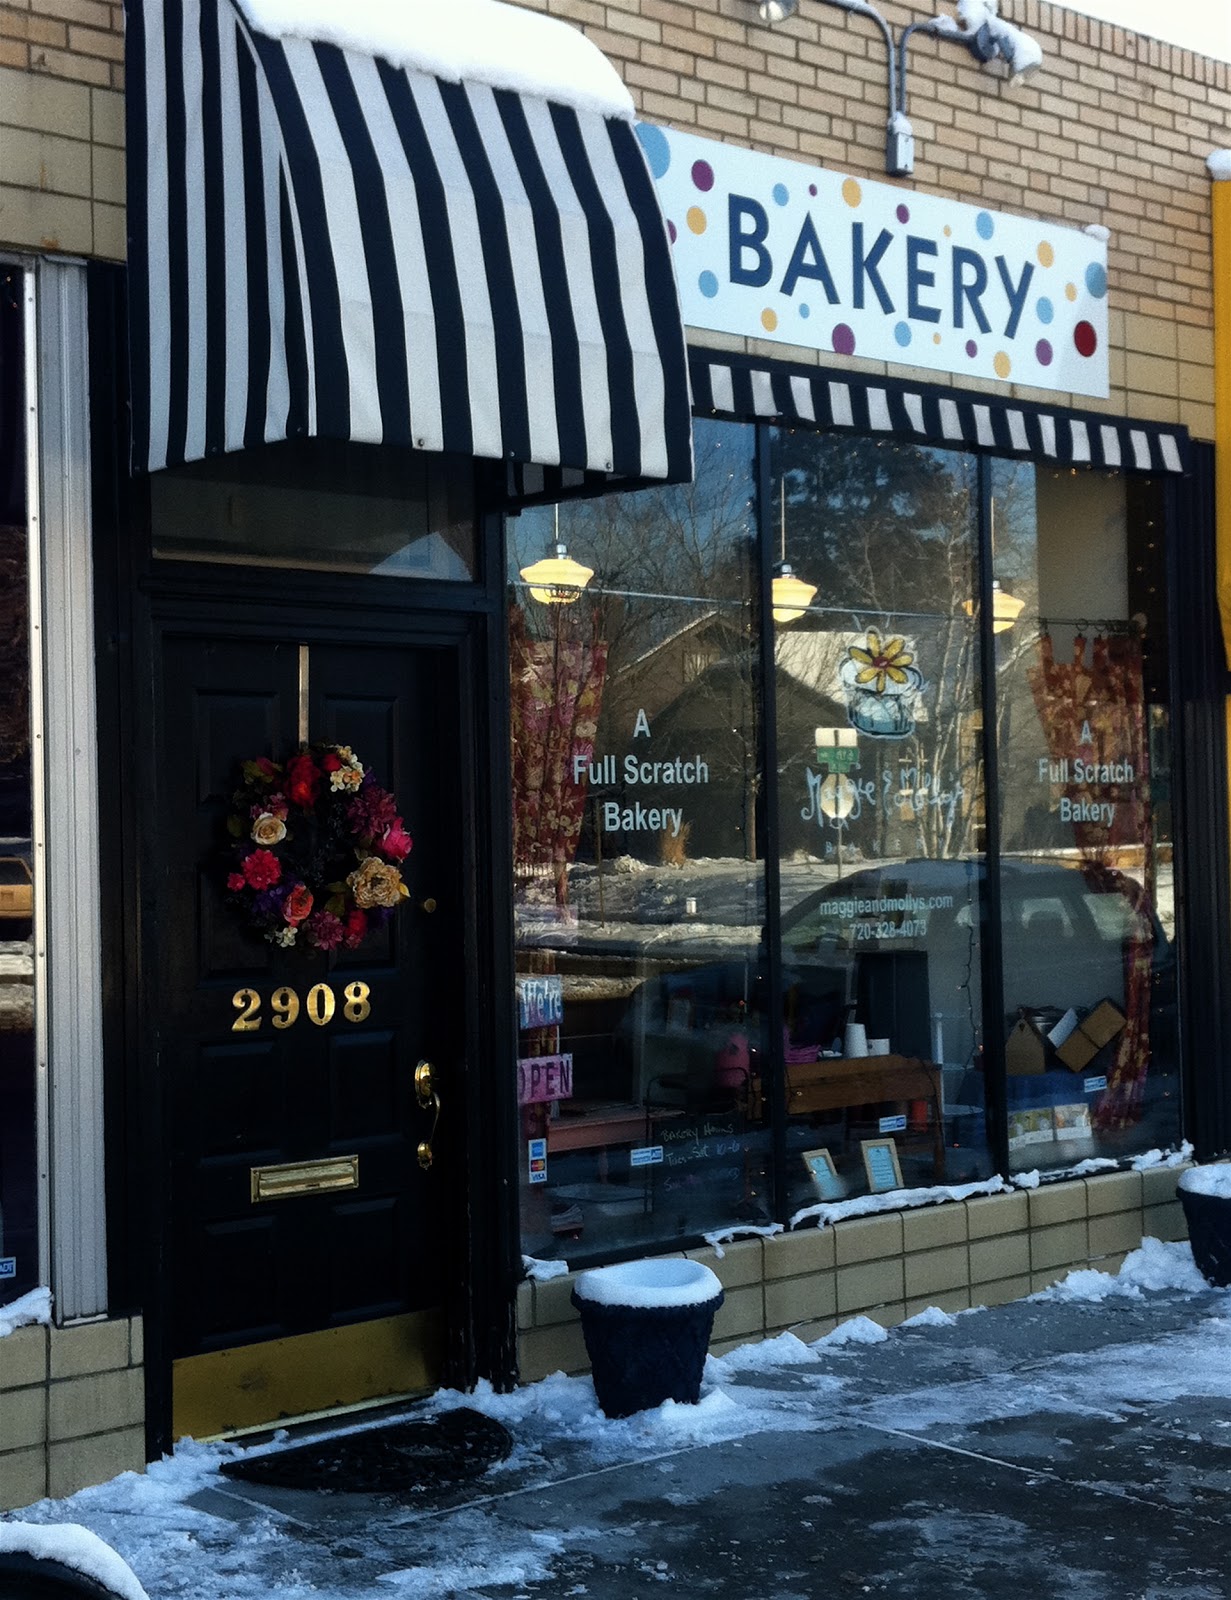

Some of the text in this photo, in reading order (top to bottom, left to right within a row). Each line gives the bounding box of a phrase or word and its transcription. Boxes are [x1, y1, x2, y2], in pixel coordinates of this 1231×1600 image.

[728, 192, 1035, 339] BAKERY
[633, 709, 651, 738] A
[1081, 721, 1092, 743] A
[573, 754, 709, 785] Full Scratch
[1038, 758, 1134, 783] Full Scratch
[604, 801, 683, 837] Bakery
[1060, 797, 1115, 828] Bakery
[819, 893, 953, 919] maggieandmollys.com
[849, 919, 927, 941] 720-328-4073
[231, 981, 372, 1032] 2908
[521, 979, 563, 1024] We're
[531, 1172, 546, 1182] VISA
